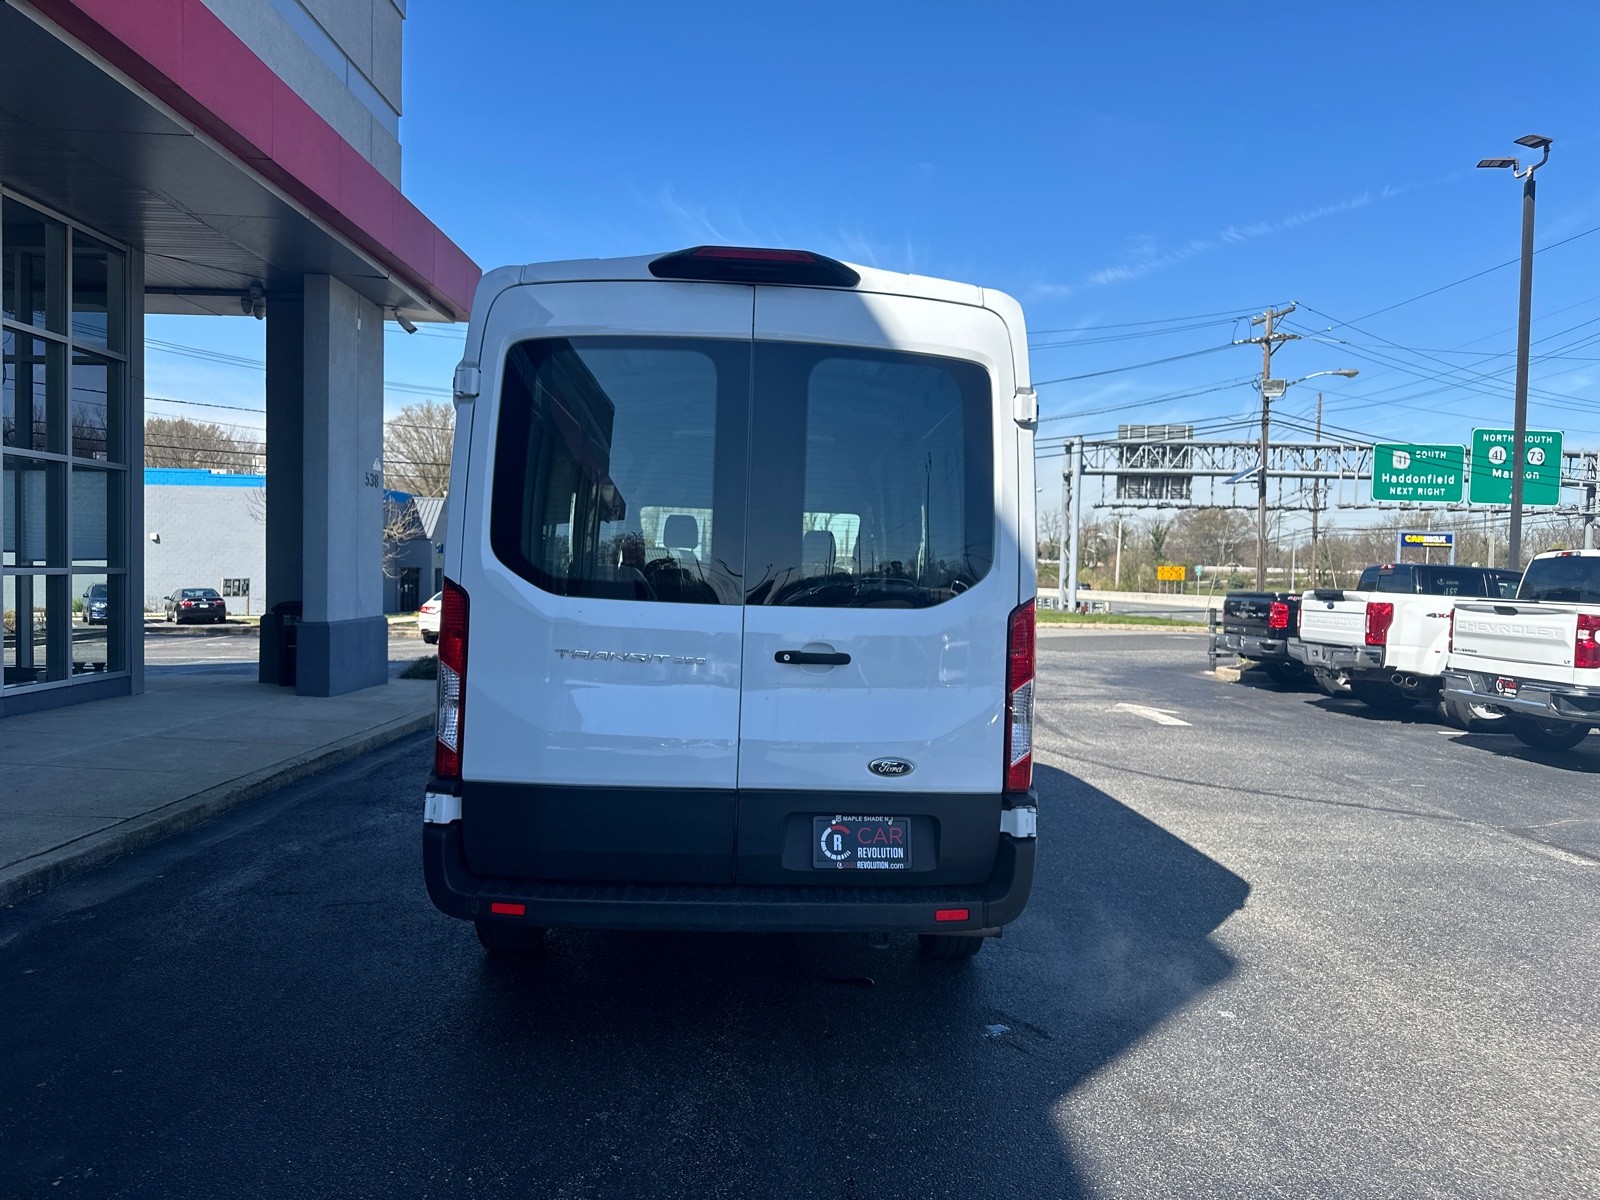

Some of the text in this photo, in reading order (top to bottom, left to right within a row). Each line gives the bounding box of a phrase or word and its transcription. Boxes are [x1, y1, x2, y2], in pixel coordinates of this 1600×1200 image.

[1483, 433, 1553, 444] NORTH SOUTH
[1415, 450, 1447, 459] SOUTH
[1491, 450, 1544, 462] 41 73
[364, 471, 379, 489] 538
[1381, 472, 1455, 485] Haddonfield
[1389, 486, 1446, 497] NEXT RIGHT
[1457, 620, 1563, 637] CHEVROLET
[554, 649, 671, 664] TRANSIT
[878, 761, 904, 773] Ford
[857, 827, 903, 844] CAR
[833, 834, 842, 851] R
[857, 847, 904, 859] REVOLUTION
